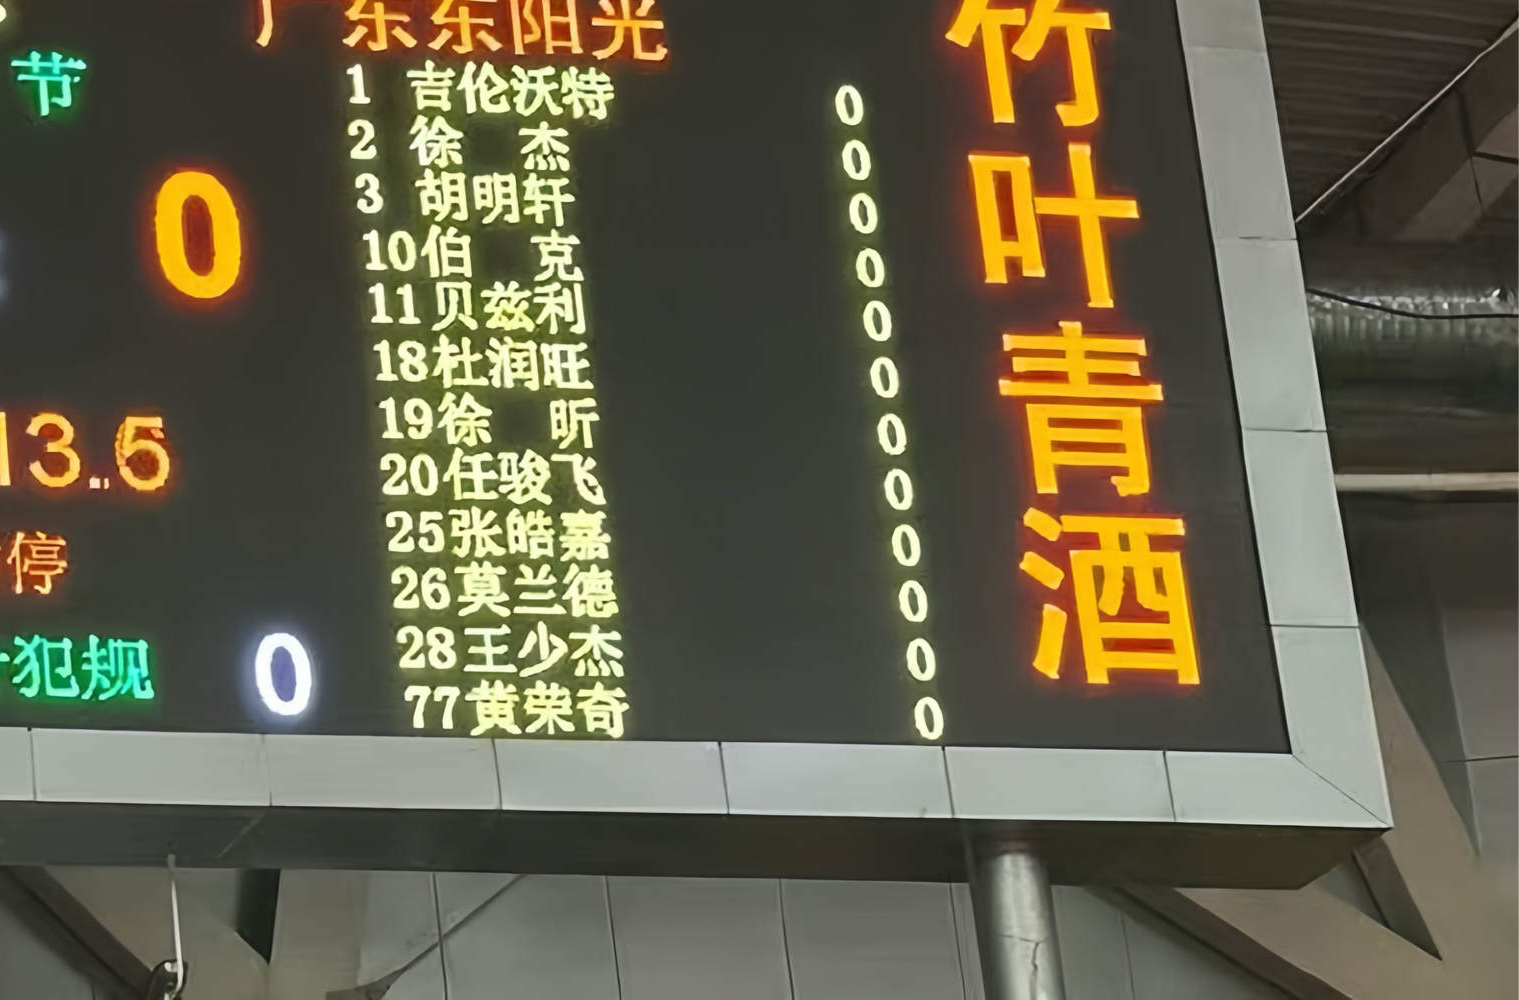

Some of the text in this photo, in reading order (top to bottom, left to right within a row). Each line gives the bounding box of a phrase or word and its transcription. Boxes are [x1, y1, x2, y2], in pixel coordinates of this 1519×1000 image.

[347, 60, 614, 120] 1 吉伦沃特
[835, 85, 863, 125] 0
[348, 119, 377, 159] 2
[842, 140, 871, 180] 0
[355, 171, 575, 226] 3 胡明轩
[849, 193, 878, 234] 0
[155, 171, 241, 298] 0
[856, 248, 885, 287] 0
[432, 281, 586, 334] 贝兹利
[863, 301, 892, 341] 0
[432, 336, 594, 391] 杜润旺
[870, 357, 899, 398] 0
[877, 414, 906, 455] 0
[443, 448, 606, 505] 任骏飞
[884, 469, 913, 510] 0
[448, 507, 611, 561] 张皓嘉
[892, 524, 921, 566] 0
[454, 561, 619, 618] 莫兰德
[899, 580, 927, 622] 0
[464, 621, 624, 677] 王少杰
[906, 638, 935, 681] 0
[255, 633, 312, 716] 0
[465, 679, 629, 738] 黄荣奇
[914, 697, 944, 740] 0
